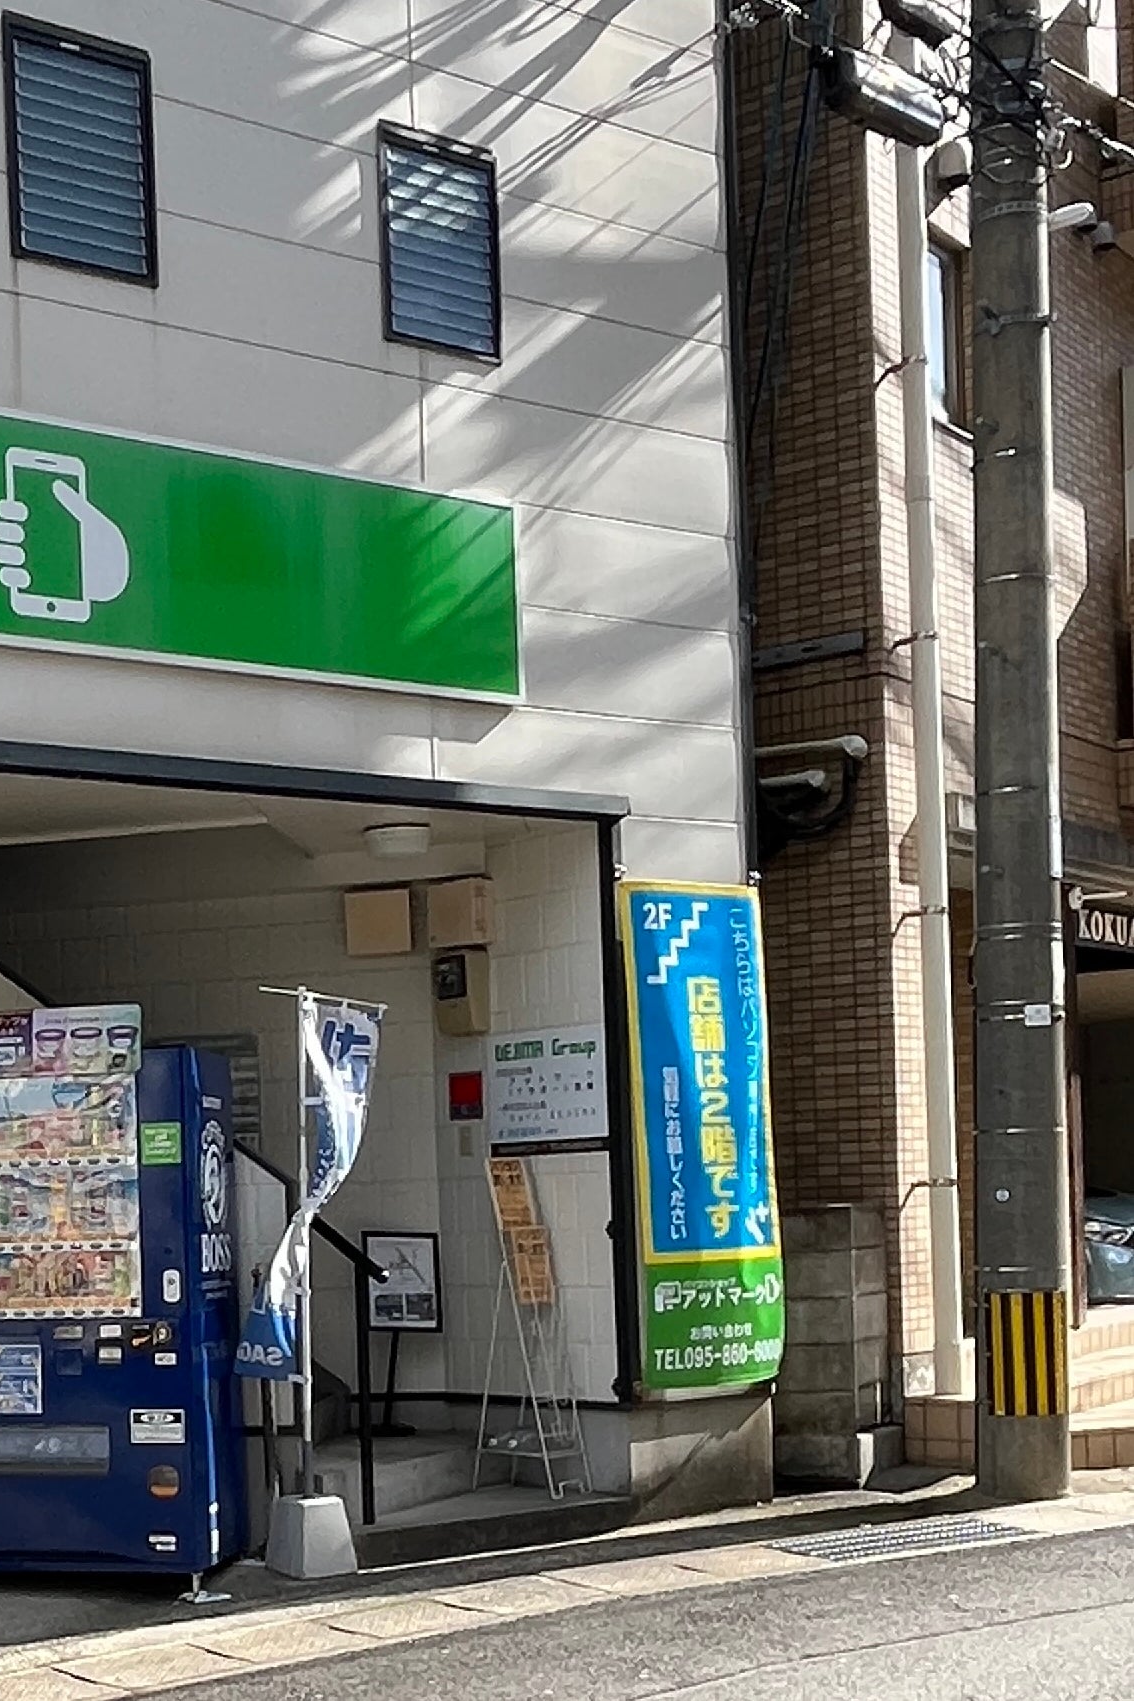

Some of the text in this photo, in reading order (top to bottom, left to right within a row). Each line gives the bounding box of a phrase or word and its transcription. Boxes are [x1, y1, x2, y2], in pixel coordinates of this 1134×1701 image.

[642, 902, 672, 931] 2F
[686, 977, 740, 1240] 店舗は2階です
[200, 1233, 232, 1273] BOSS
[682, 1286, 764, 1309] アットマーク
